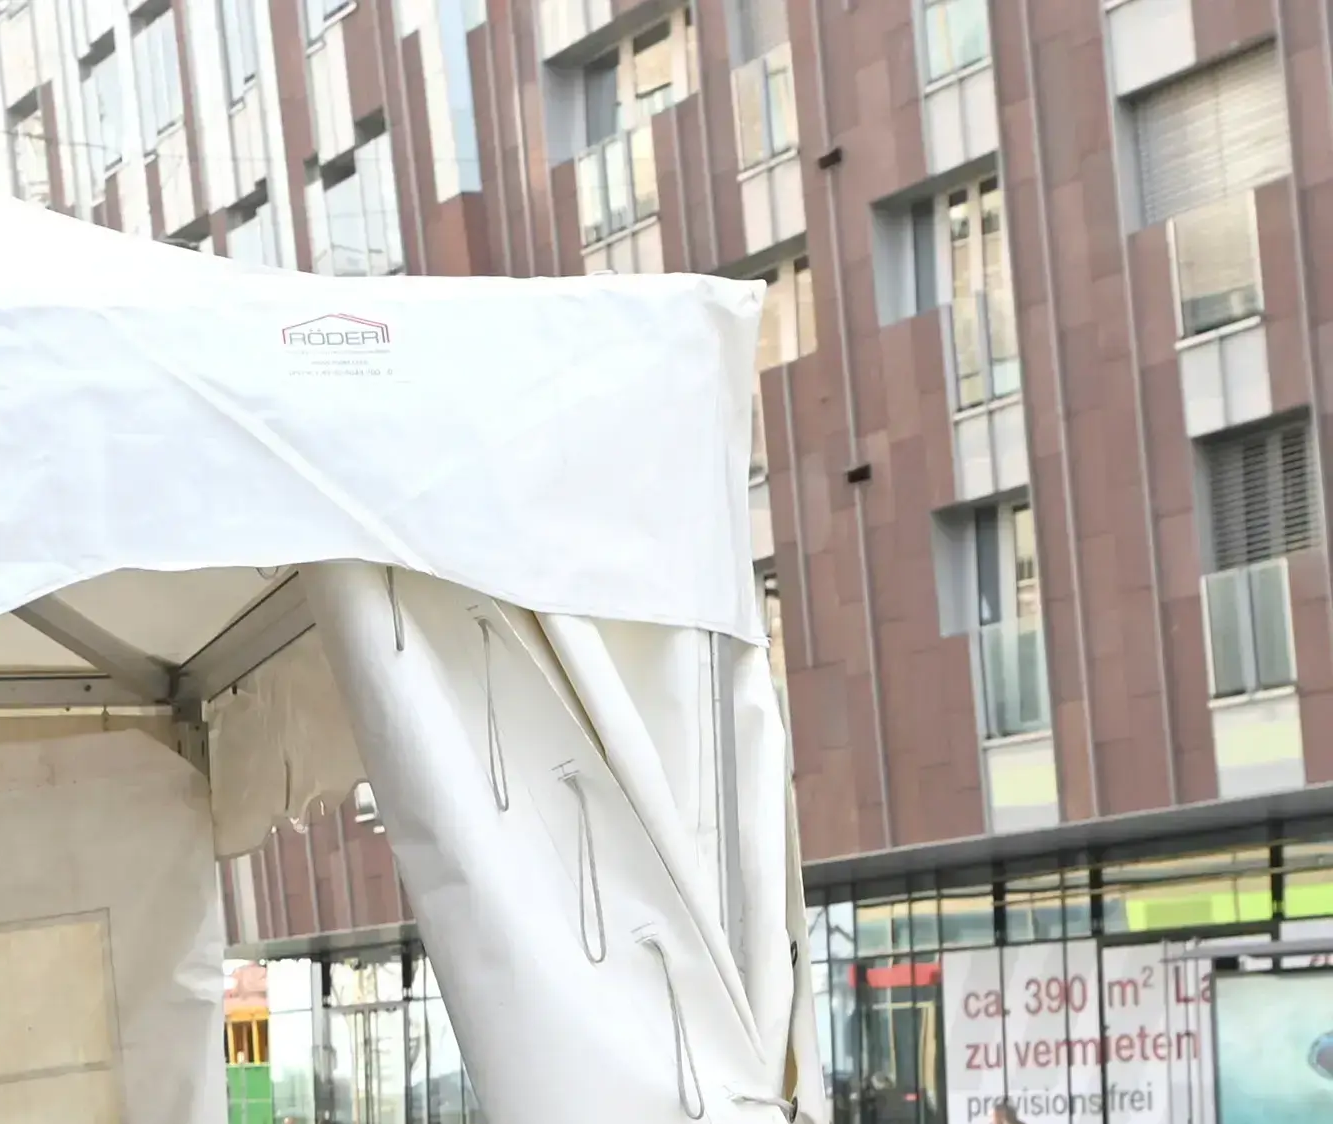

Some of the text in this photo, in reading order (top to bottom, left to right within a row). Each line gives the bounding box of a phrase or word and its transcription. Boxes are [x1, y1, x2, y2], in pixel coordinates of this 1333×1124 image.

[288, 327, 380, 346] RÖDER
[963, 988, 1011, 1019] ca.
[1025, 974, 1088, 1016] 390
[965, 1024, 1200, 1071] zu vermieten
